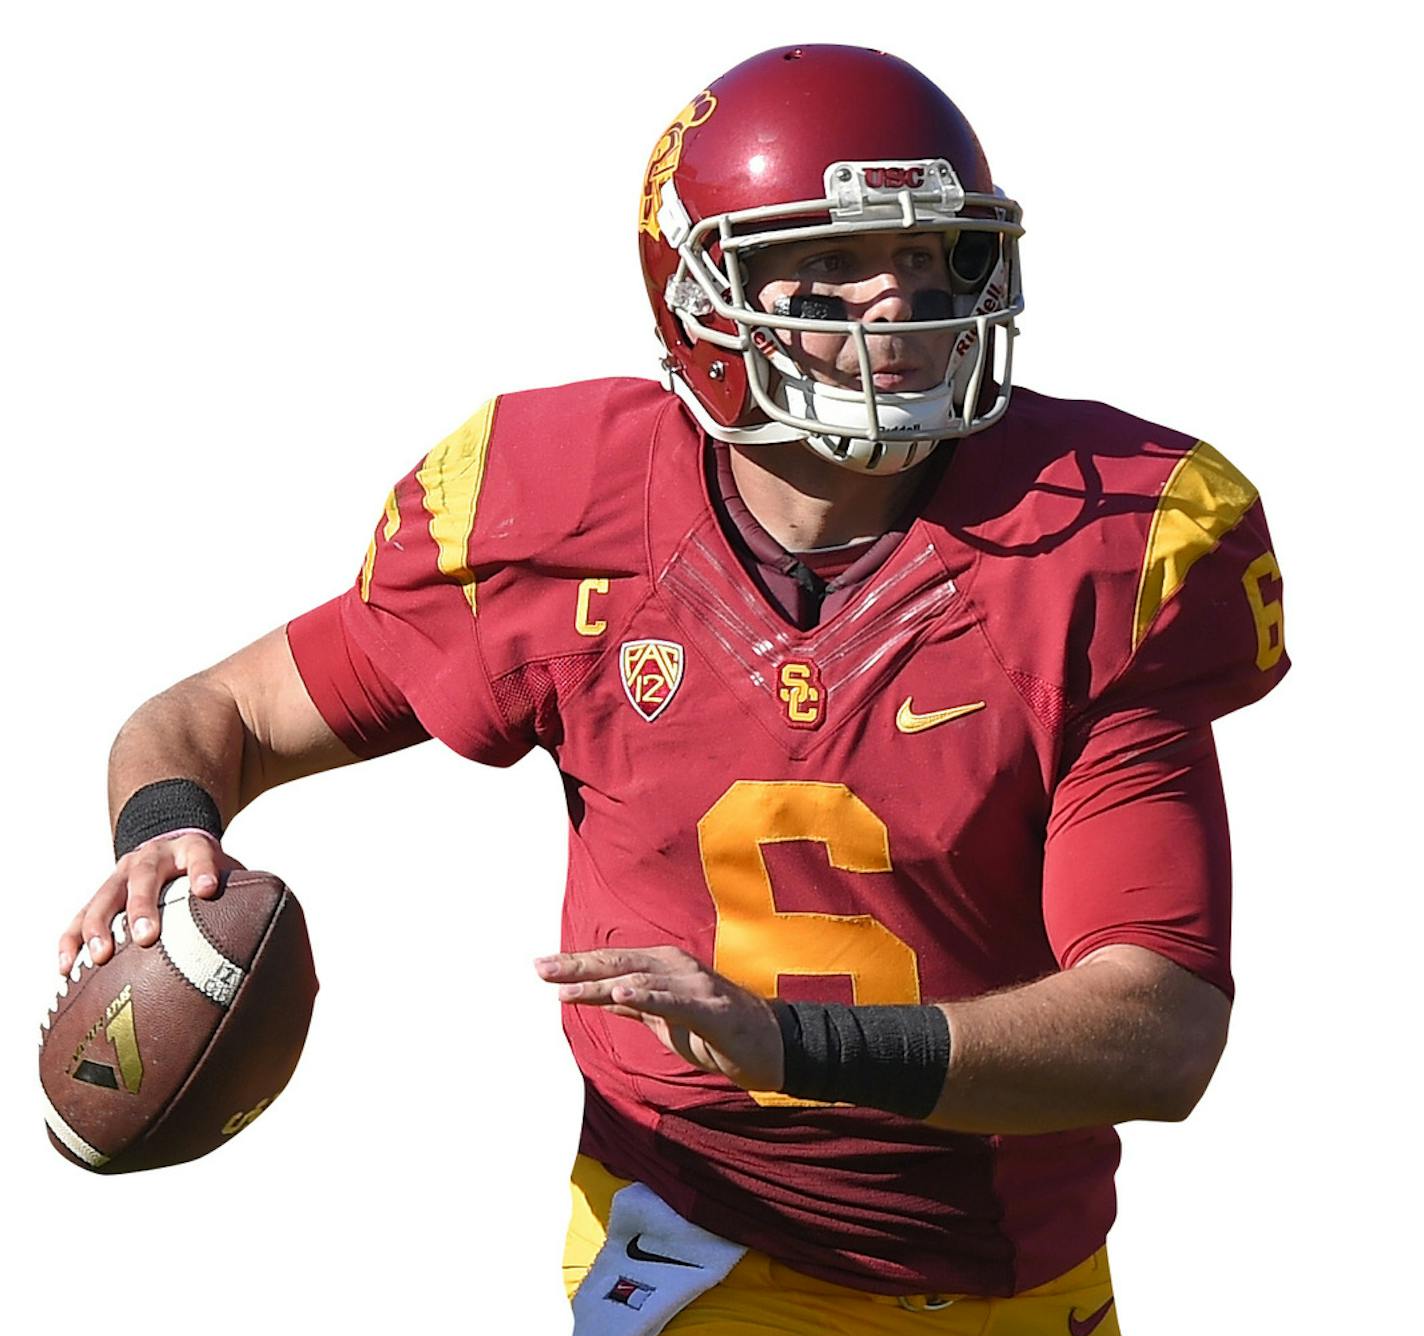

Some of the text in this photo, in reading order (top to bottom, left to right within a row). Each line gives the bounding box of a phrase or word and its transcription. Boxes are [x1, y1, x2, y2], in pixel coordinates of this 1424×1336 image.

[862, 167, 924, 189] USC
[575, 578, 611, 636] C
[1242, 550, 1284, 672] 6
[624, 643, 680, 690] PAC
[635, 673, 665, 703] 12
[779, 664, 819, 722] SC
[697, 779, 921, 1107] 6
